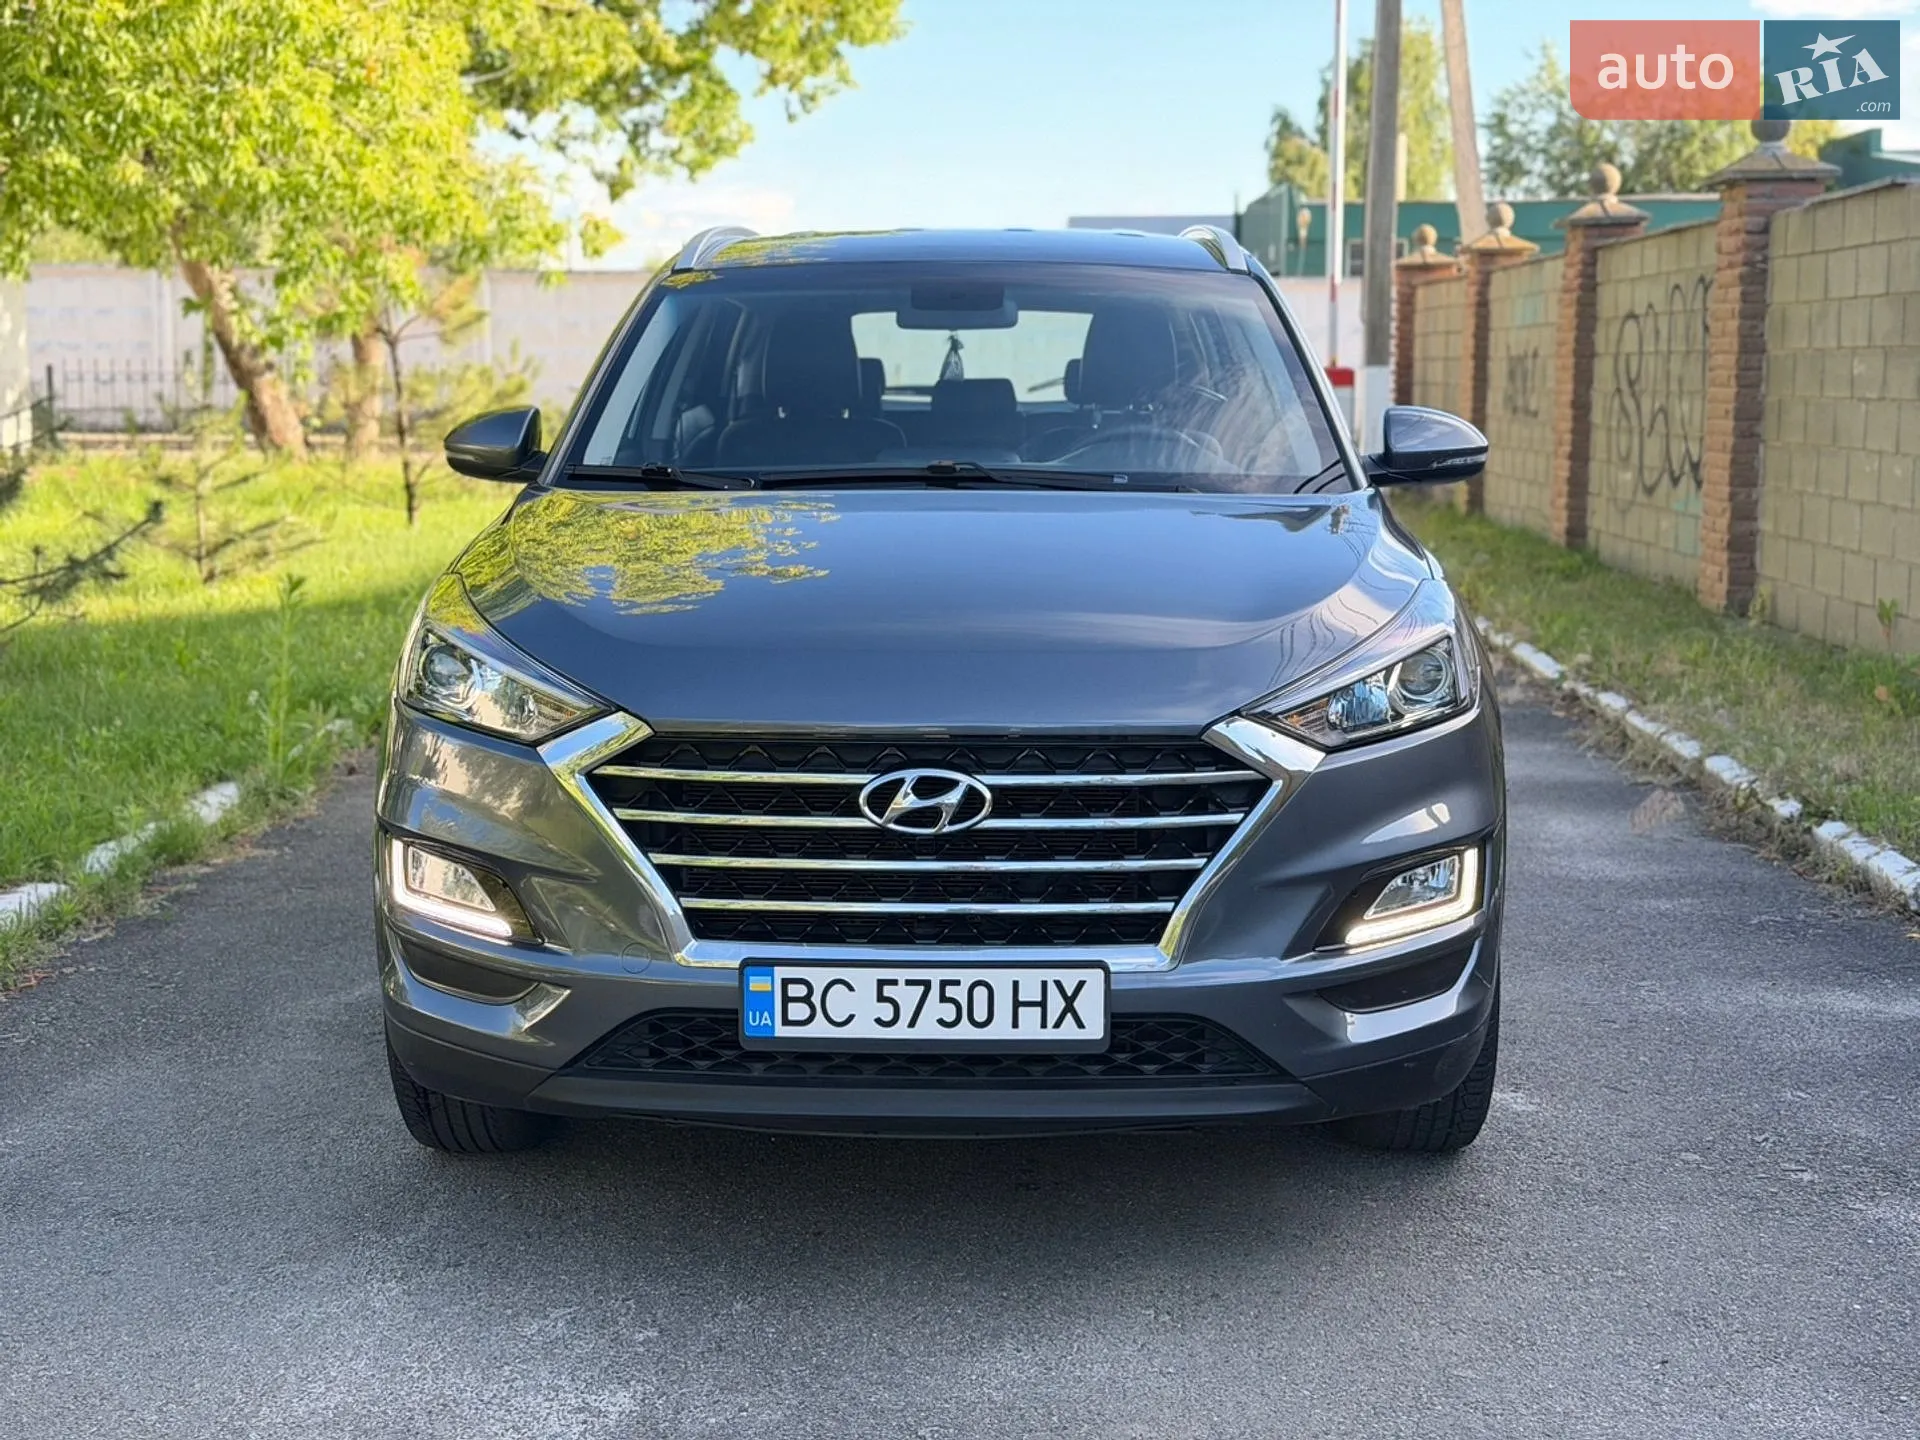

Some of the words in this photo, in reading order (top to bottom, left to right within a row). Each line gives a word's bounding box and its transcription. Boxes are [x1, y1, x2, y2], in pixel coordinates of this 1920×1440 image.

[749, 1010, 772, 1027] UA
[780, 977, 856, 1028] BC
[873, 978, 995, 1029] 5750
[1011, 979, 1087, 1030] HX
